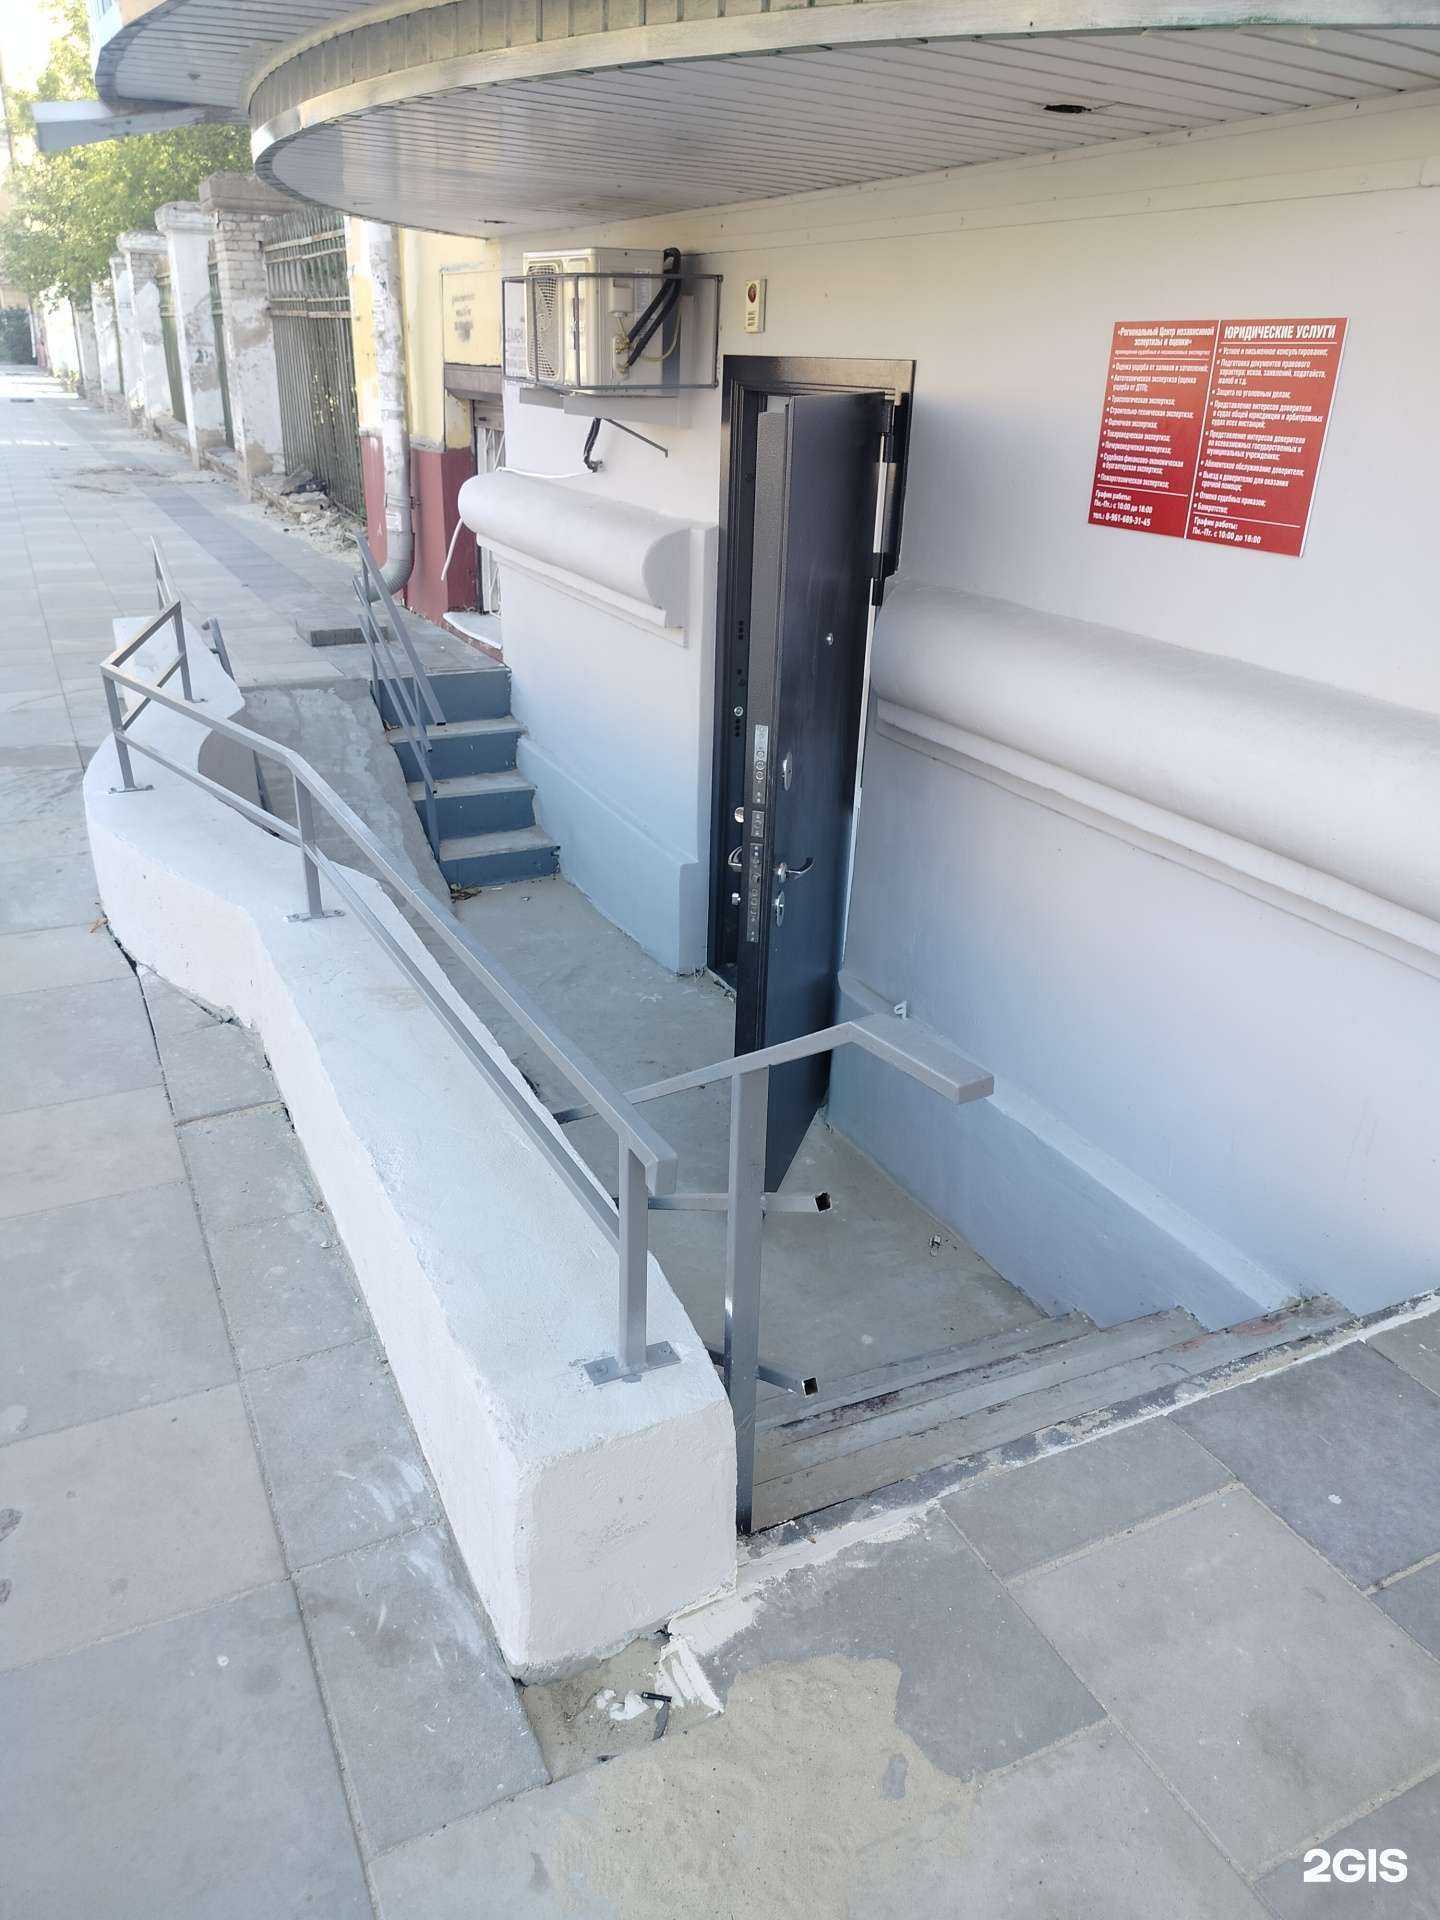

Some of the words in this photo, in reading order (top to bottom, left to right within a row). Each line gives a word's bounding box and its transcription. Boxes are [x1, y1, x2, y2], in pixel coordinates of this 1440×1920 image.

[1224, 326, 1294, 340] ЮРИДИЧЕСКИЕ
[1296, 325, 1336, 338] УСЛУГИ
[1194, 517, 1214, 528] График
